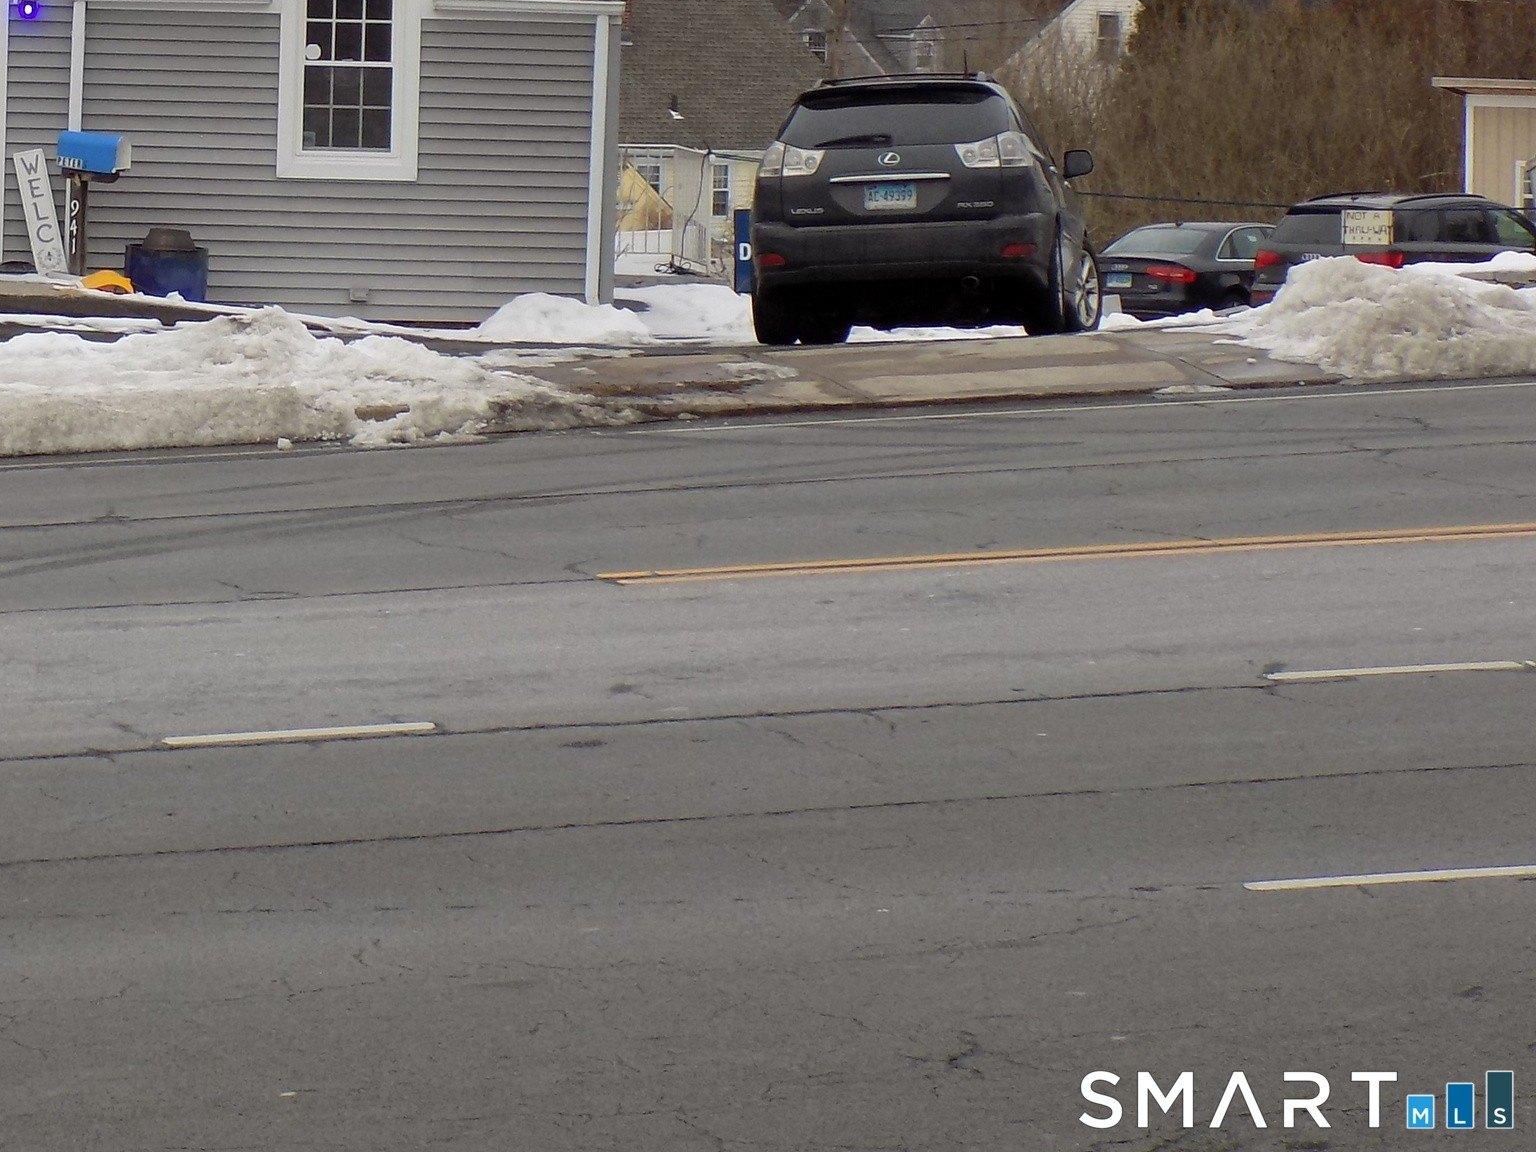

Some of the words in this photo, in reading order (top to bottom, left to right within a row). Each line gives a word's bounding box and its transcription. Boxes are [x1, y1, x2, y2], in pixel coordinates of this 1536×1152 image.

[790, 207, 825, 215] LEXUS
[1346, 211, 1367, 221] NOT
[70, 199, 80, 255] 941
